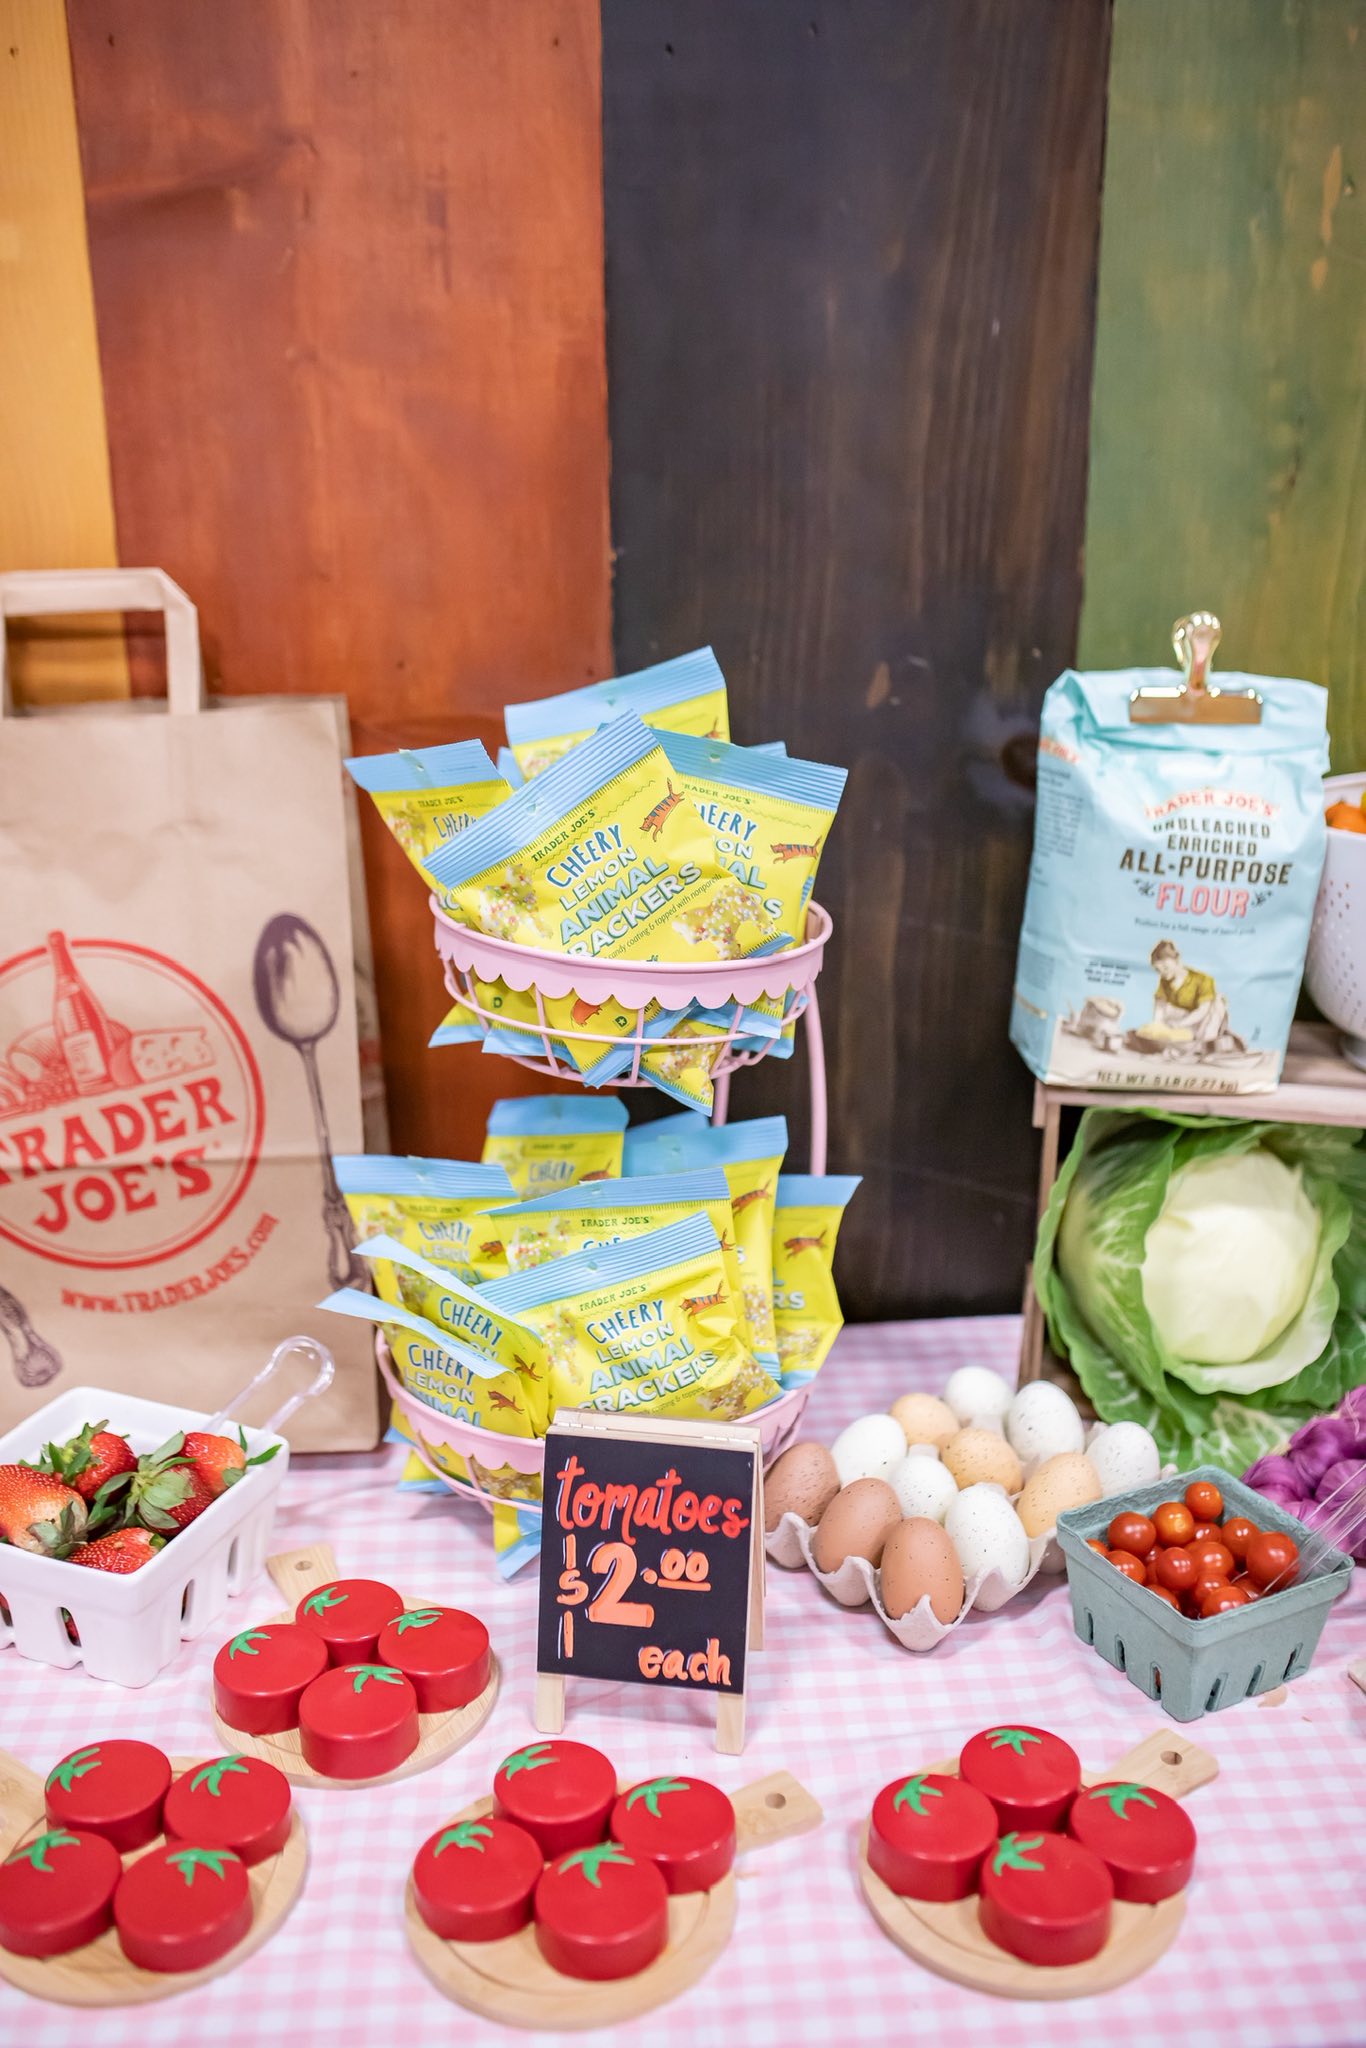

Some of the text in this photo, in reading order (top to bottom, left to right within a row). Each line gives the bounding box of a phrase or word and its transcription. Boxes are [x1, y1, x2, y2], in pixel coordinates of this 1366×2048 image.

[531, 808, 597, 862] TRADER JOE'S
[545, 824, 623, 889] CHEERY
[1167, 834, 1258, 858] ENRICHED
[559, 846, 638, 912] LEMON
[1119, 847, 1293, 886] ALL-PURPOSE
[559, 856, 670, 946] ANIMAL
[567, 861, 703, 958] RACKERS
[1155, 881, 1250, 918] FLOUR
[32, 1146, 213, 1234] JOE'S
[580, 1215, 650, 1228] TRADER JOE'S
[440, 1296, 503, 1347] CHEERY
[579, 1283, 647, 1312] TRADER JOE'S
[586, 1299, 664, 1345] CHEERY
[408, 1343, 475, 1387] CHEERY
[590, 1333, 696, 1395] ANIMAL
[596, 1321, 675, 1364] LEMON
[403, 1366, 475, 1406] LEMON
[556, 1455, 749, 1546] tomatoes
[638, 1637, 731, 1687] each
